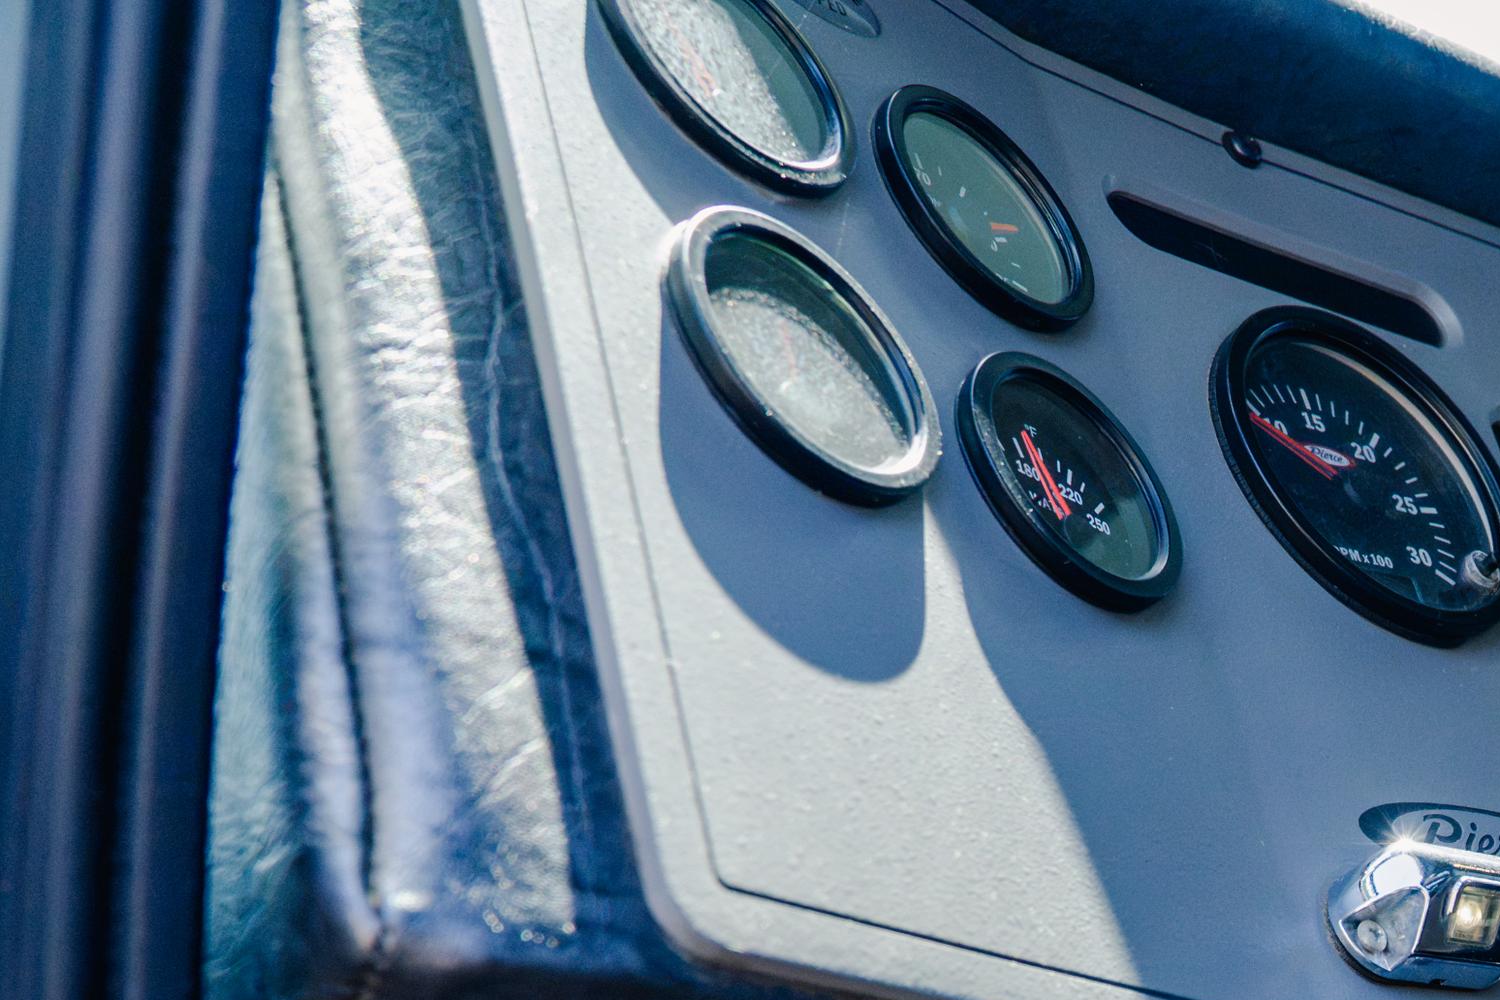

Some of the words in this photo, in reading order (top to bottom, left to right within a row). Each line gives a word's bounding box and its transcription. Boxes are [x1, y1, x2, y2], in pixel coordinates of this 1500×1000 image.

[1301, 411, 1326, 433] 15
[1350, 442, 1376, 463] 20
[1016, 460, 1041, 482] 180
[1058, 484, 1083, 506] 220
[1392, 494, 1419, 515] 25
[1086, 514, 1111, 536] 250
[1406, 546, 1433, 567] 30
